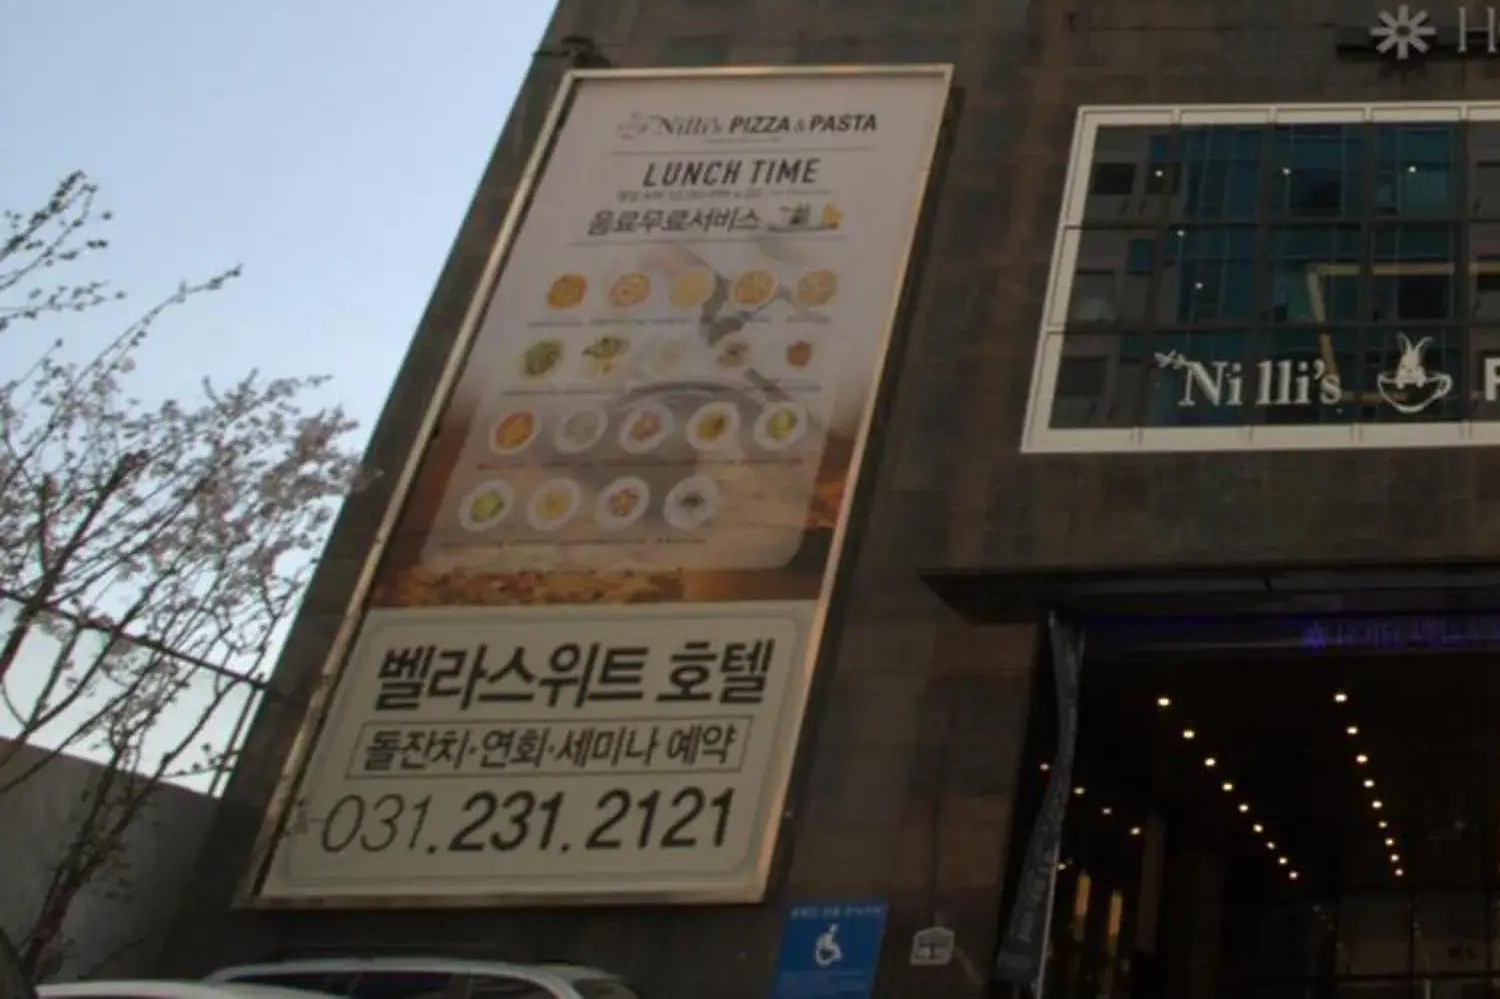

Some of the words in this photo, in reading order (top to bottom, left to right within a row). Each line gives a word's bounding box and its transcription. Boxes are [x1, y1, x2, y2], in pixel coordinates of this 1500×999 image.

[728, 115, 791, 135] PIZZA
[808, 113, 878, 133] PASTA
[642, 159, 742, 188] LUNCH
[750, 157, 822, 184] TIME
[375, 640, 649, 711] 벨라스위트
[655, 637, 776, 707] 호텔
[665, 722, 738, 765] 예약
[320, 786, 737, 855] 031.231.2121
